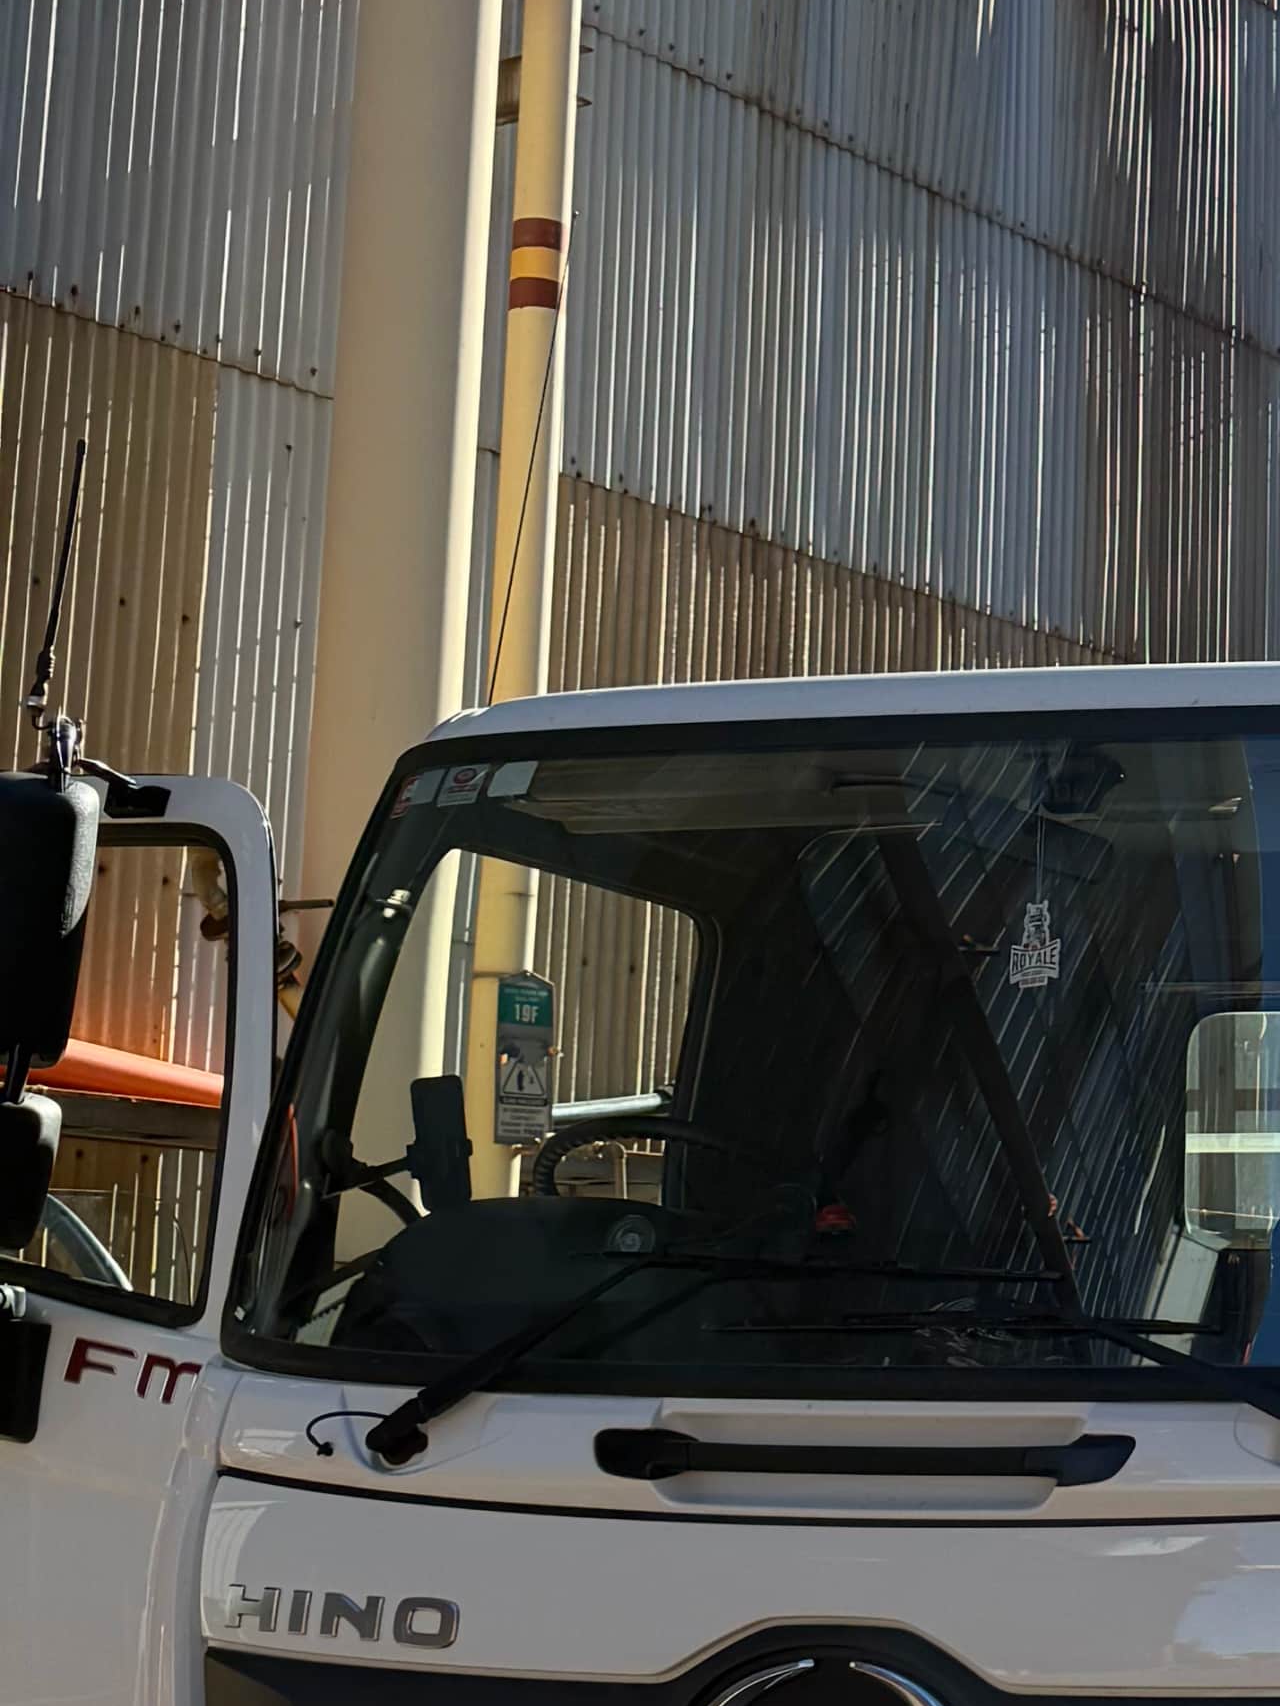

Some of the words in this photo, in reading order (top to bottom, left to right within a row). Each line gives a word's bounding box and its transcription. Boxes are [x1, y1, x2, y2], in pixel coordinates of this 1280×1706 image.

[1011, 946, 1057, 975] ROYALE
[513, 1003, 539, 1024] 19F
[224, 1583, 461, 1650] HINO
